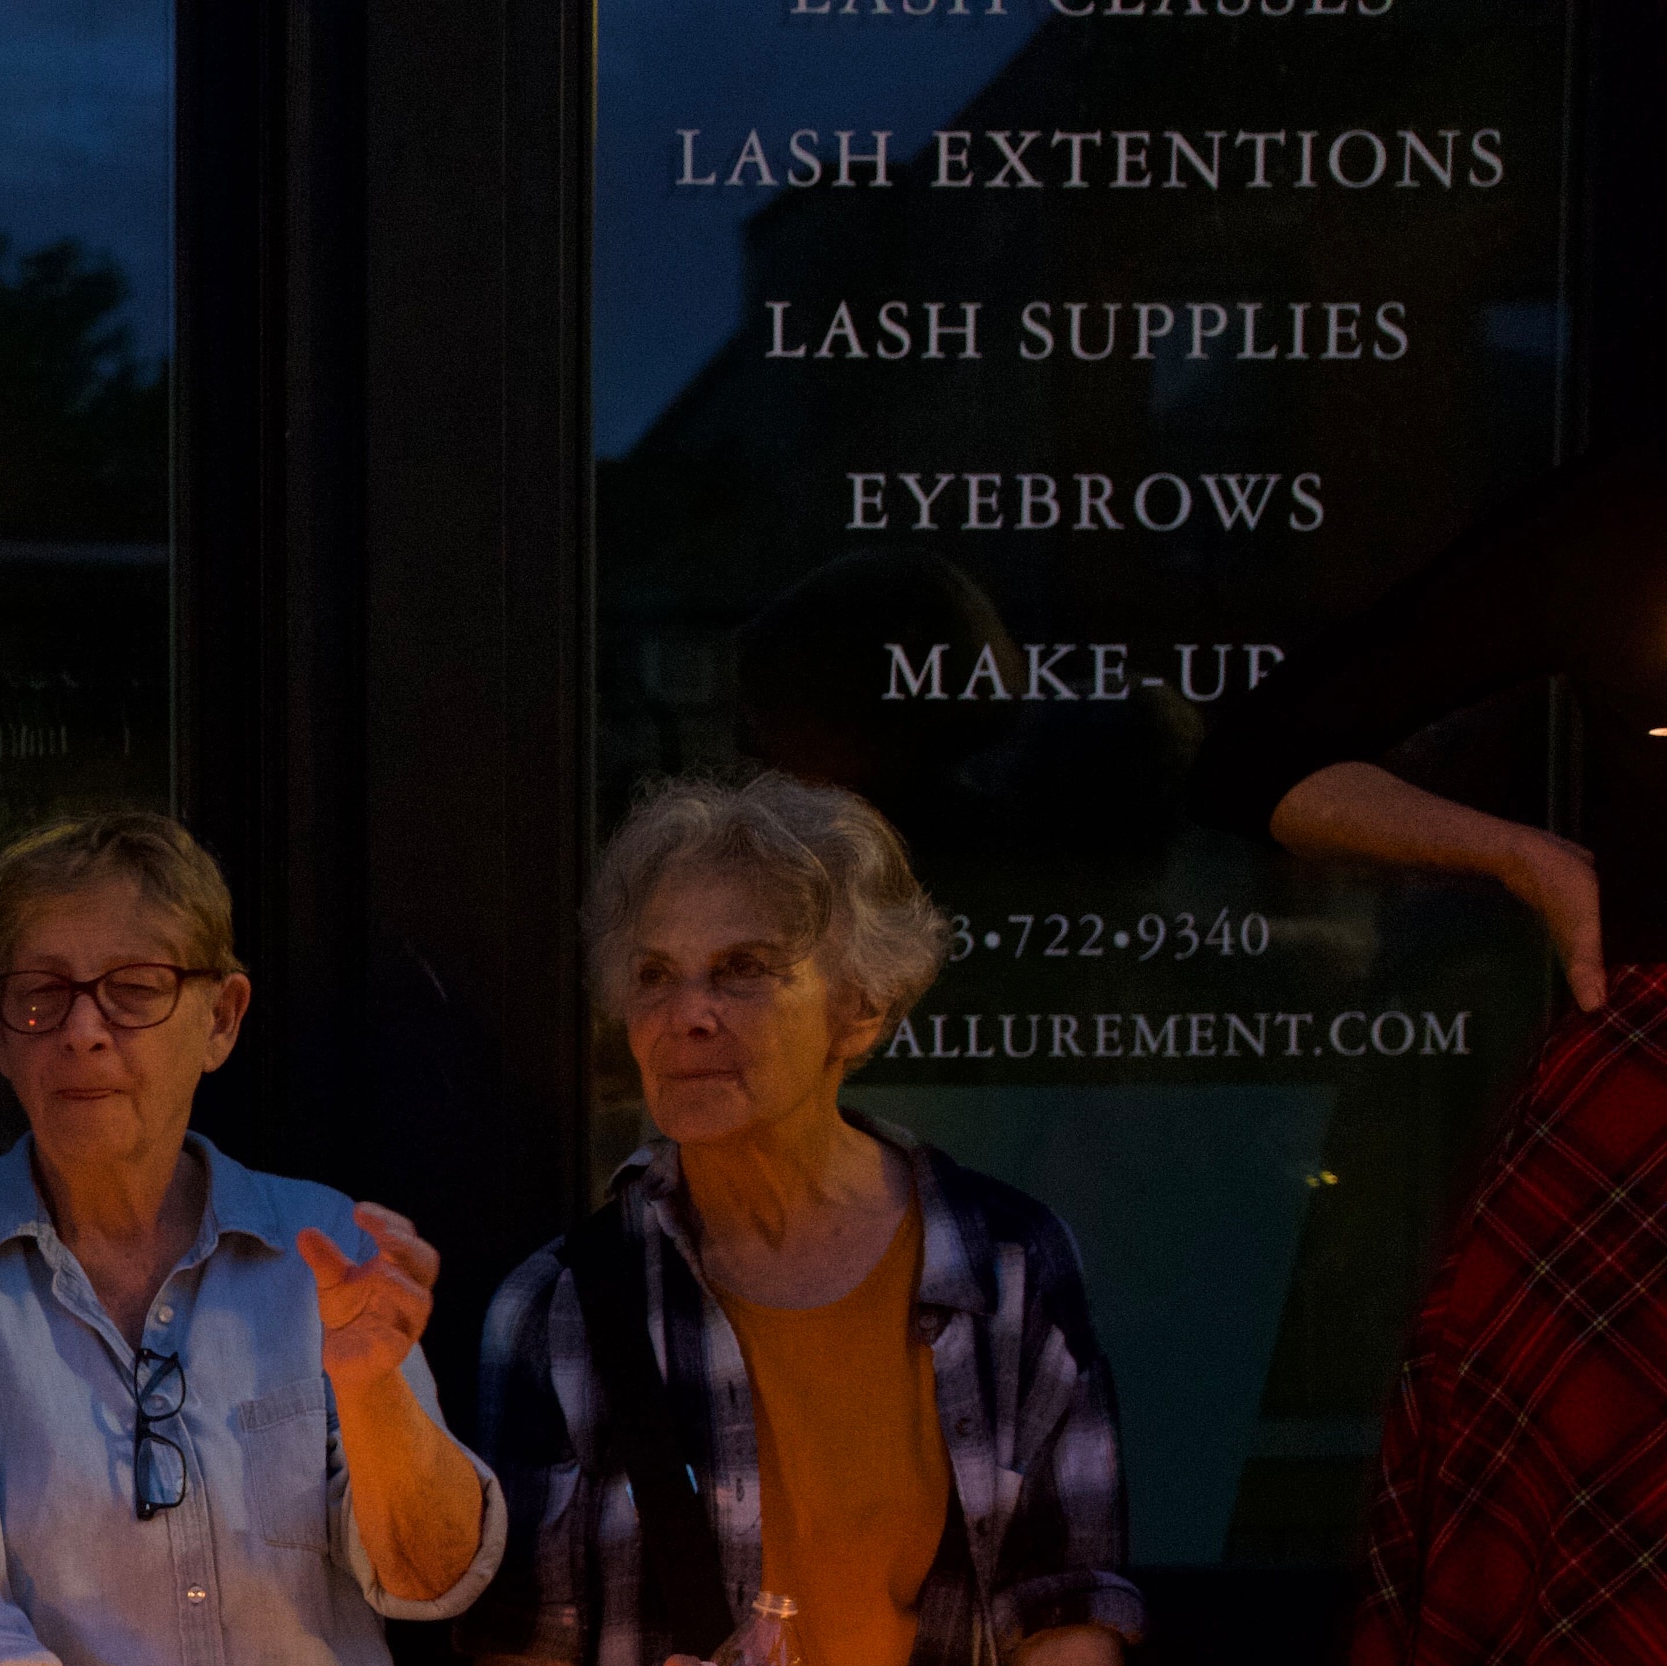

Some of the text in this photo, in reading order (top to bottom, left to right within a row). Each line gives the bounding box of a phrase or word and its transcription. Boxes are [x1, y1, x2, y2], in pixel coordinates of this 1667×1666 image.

[675, 128, 1505, 189] LASH EXTENTIONS
[765, 301, 1409, 360] LASH SUPPLIES
[846, 472, 1325, 531] EYEBROWS
